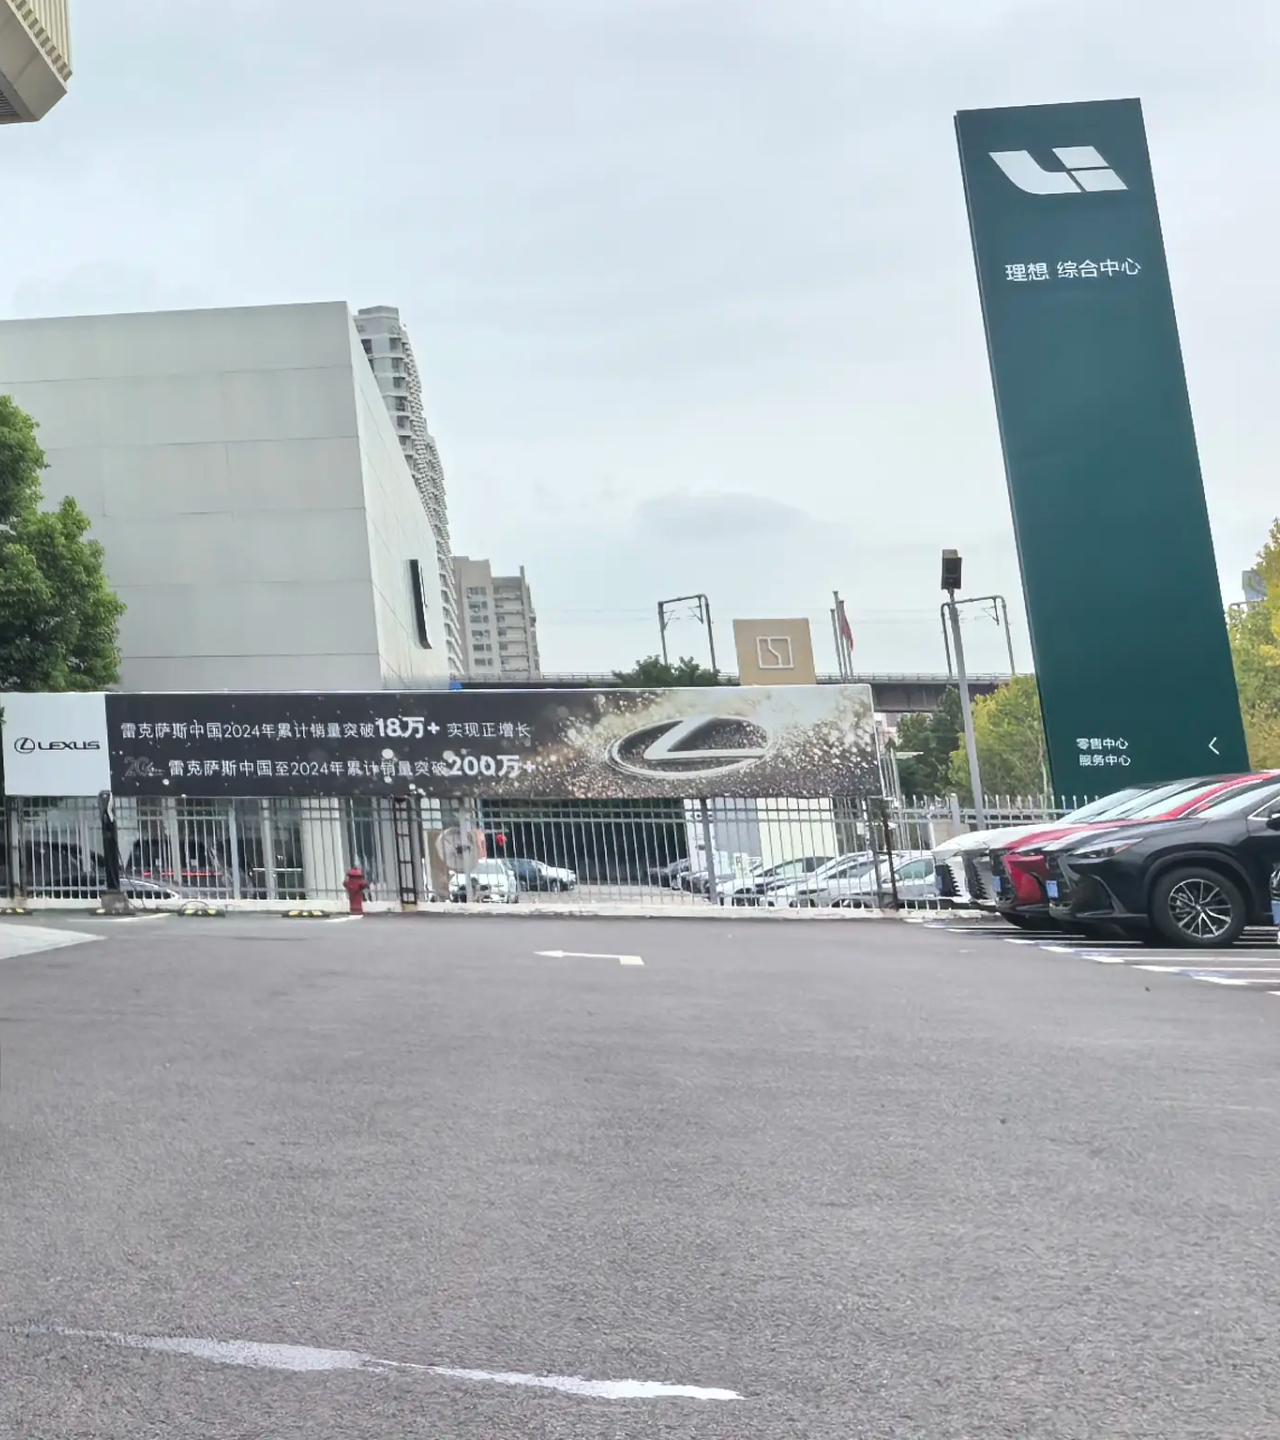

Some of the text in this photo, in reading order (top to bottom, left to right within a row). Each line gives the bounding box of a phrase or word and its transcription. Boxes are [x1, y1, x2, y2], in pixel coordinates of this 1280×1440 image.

[1005, 258, 1141, 282] 理想 综合中心
[447, 721, 531, 738] 实现正增长
[37, 740, 100, 751] LEXUS
